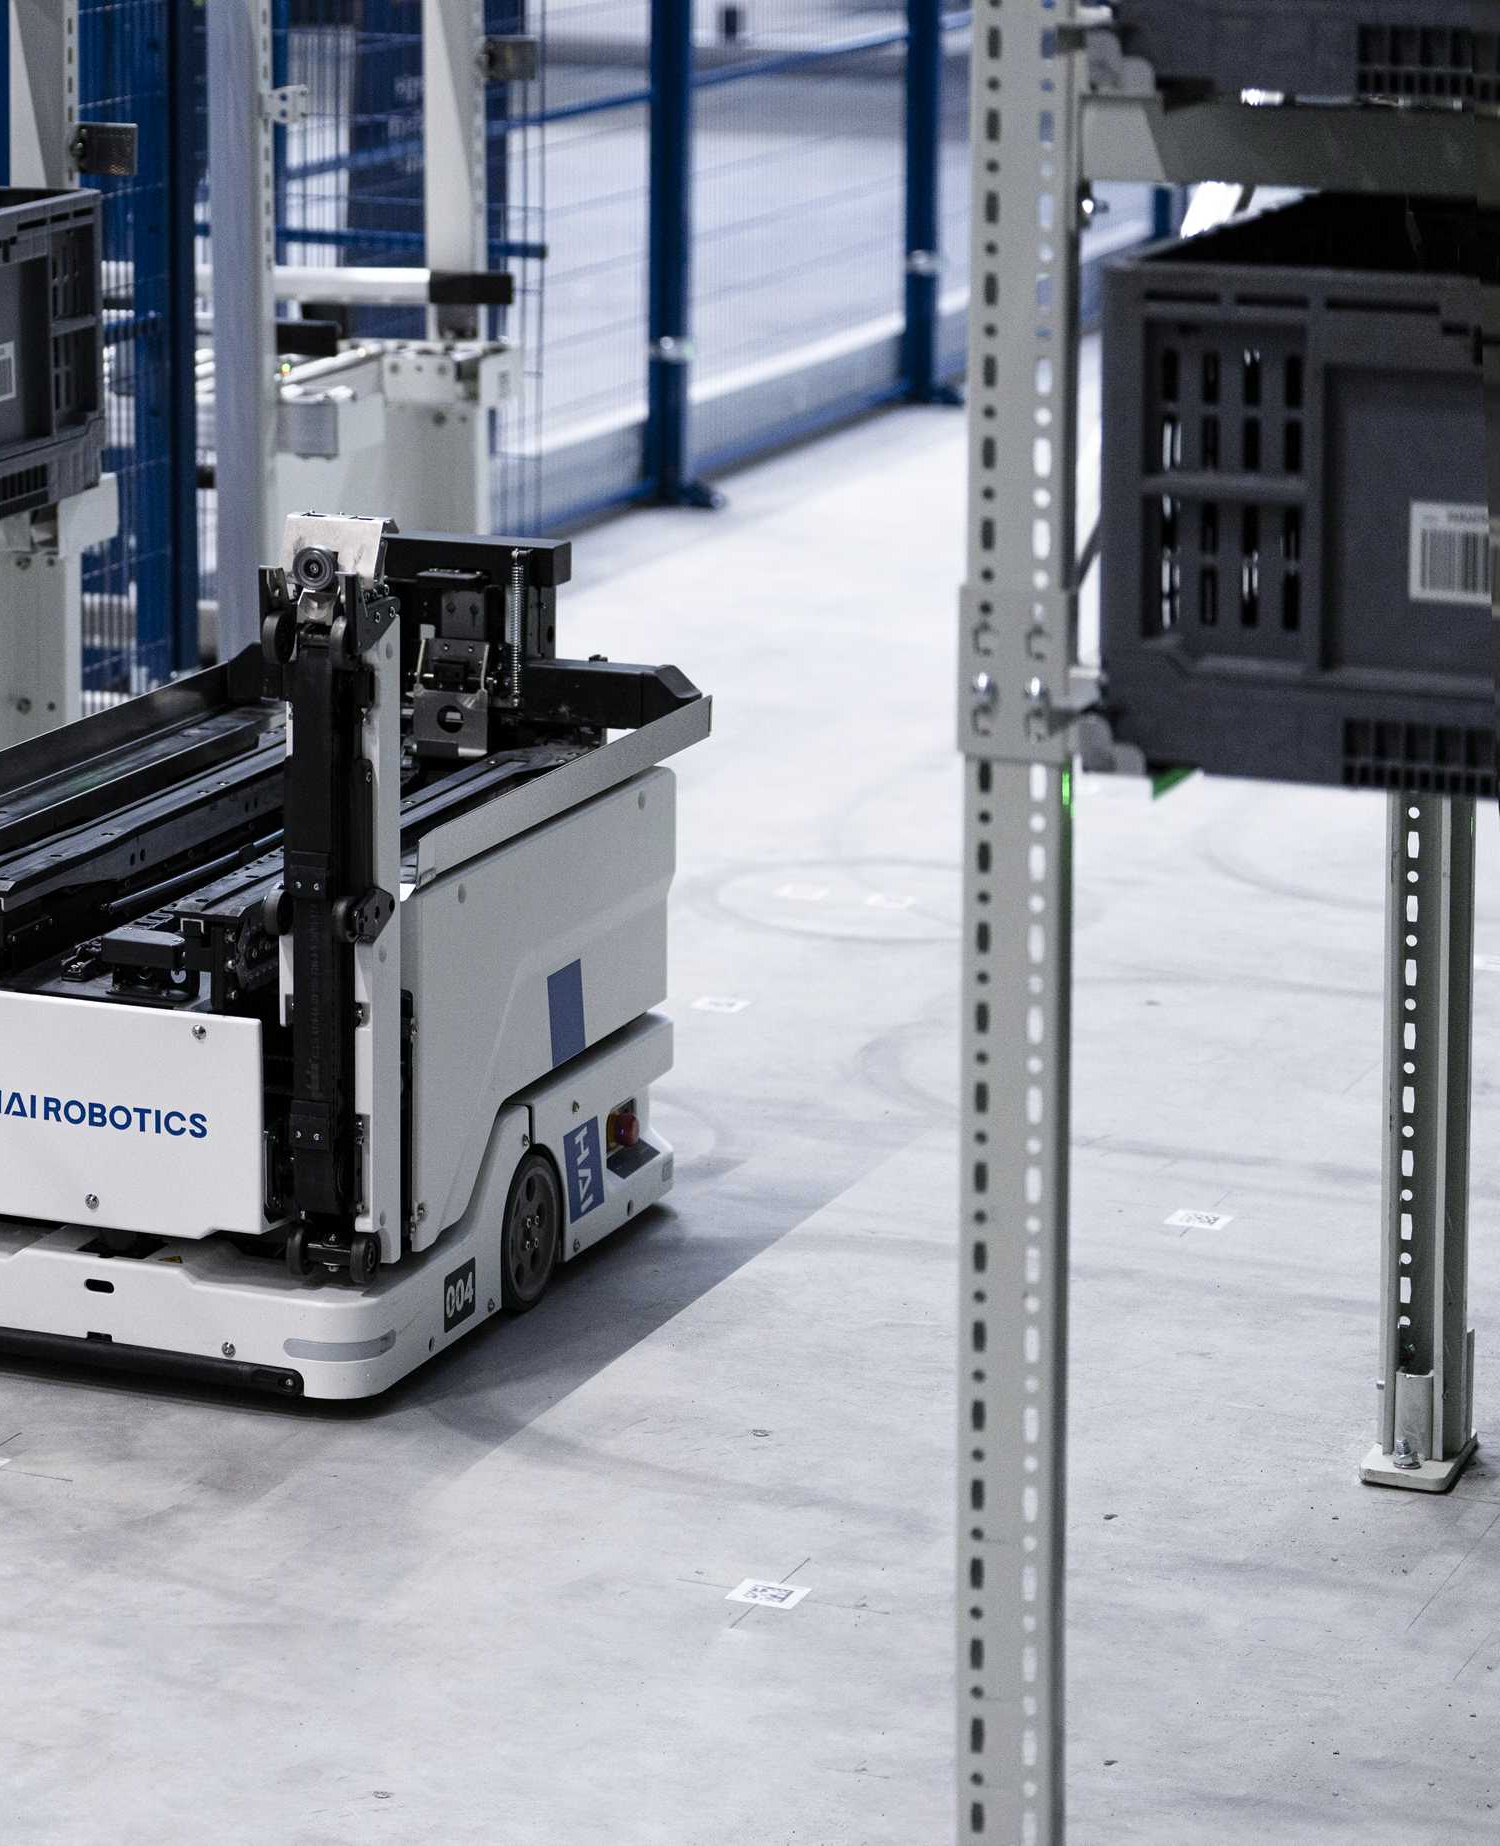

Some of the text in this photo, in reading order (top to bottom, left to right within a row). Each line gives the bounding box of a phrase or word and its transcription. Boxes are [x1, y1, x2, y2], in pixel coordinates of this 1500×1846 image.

[43, 1095, 209, 1140] ROBOTICS
[574, 1125, 594, 1213] HAI
[446, 1271, 474, 1319] 004
